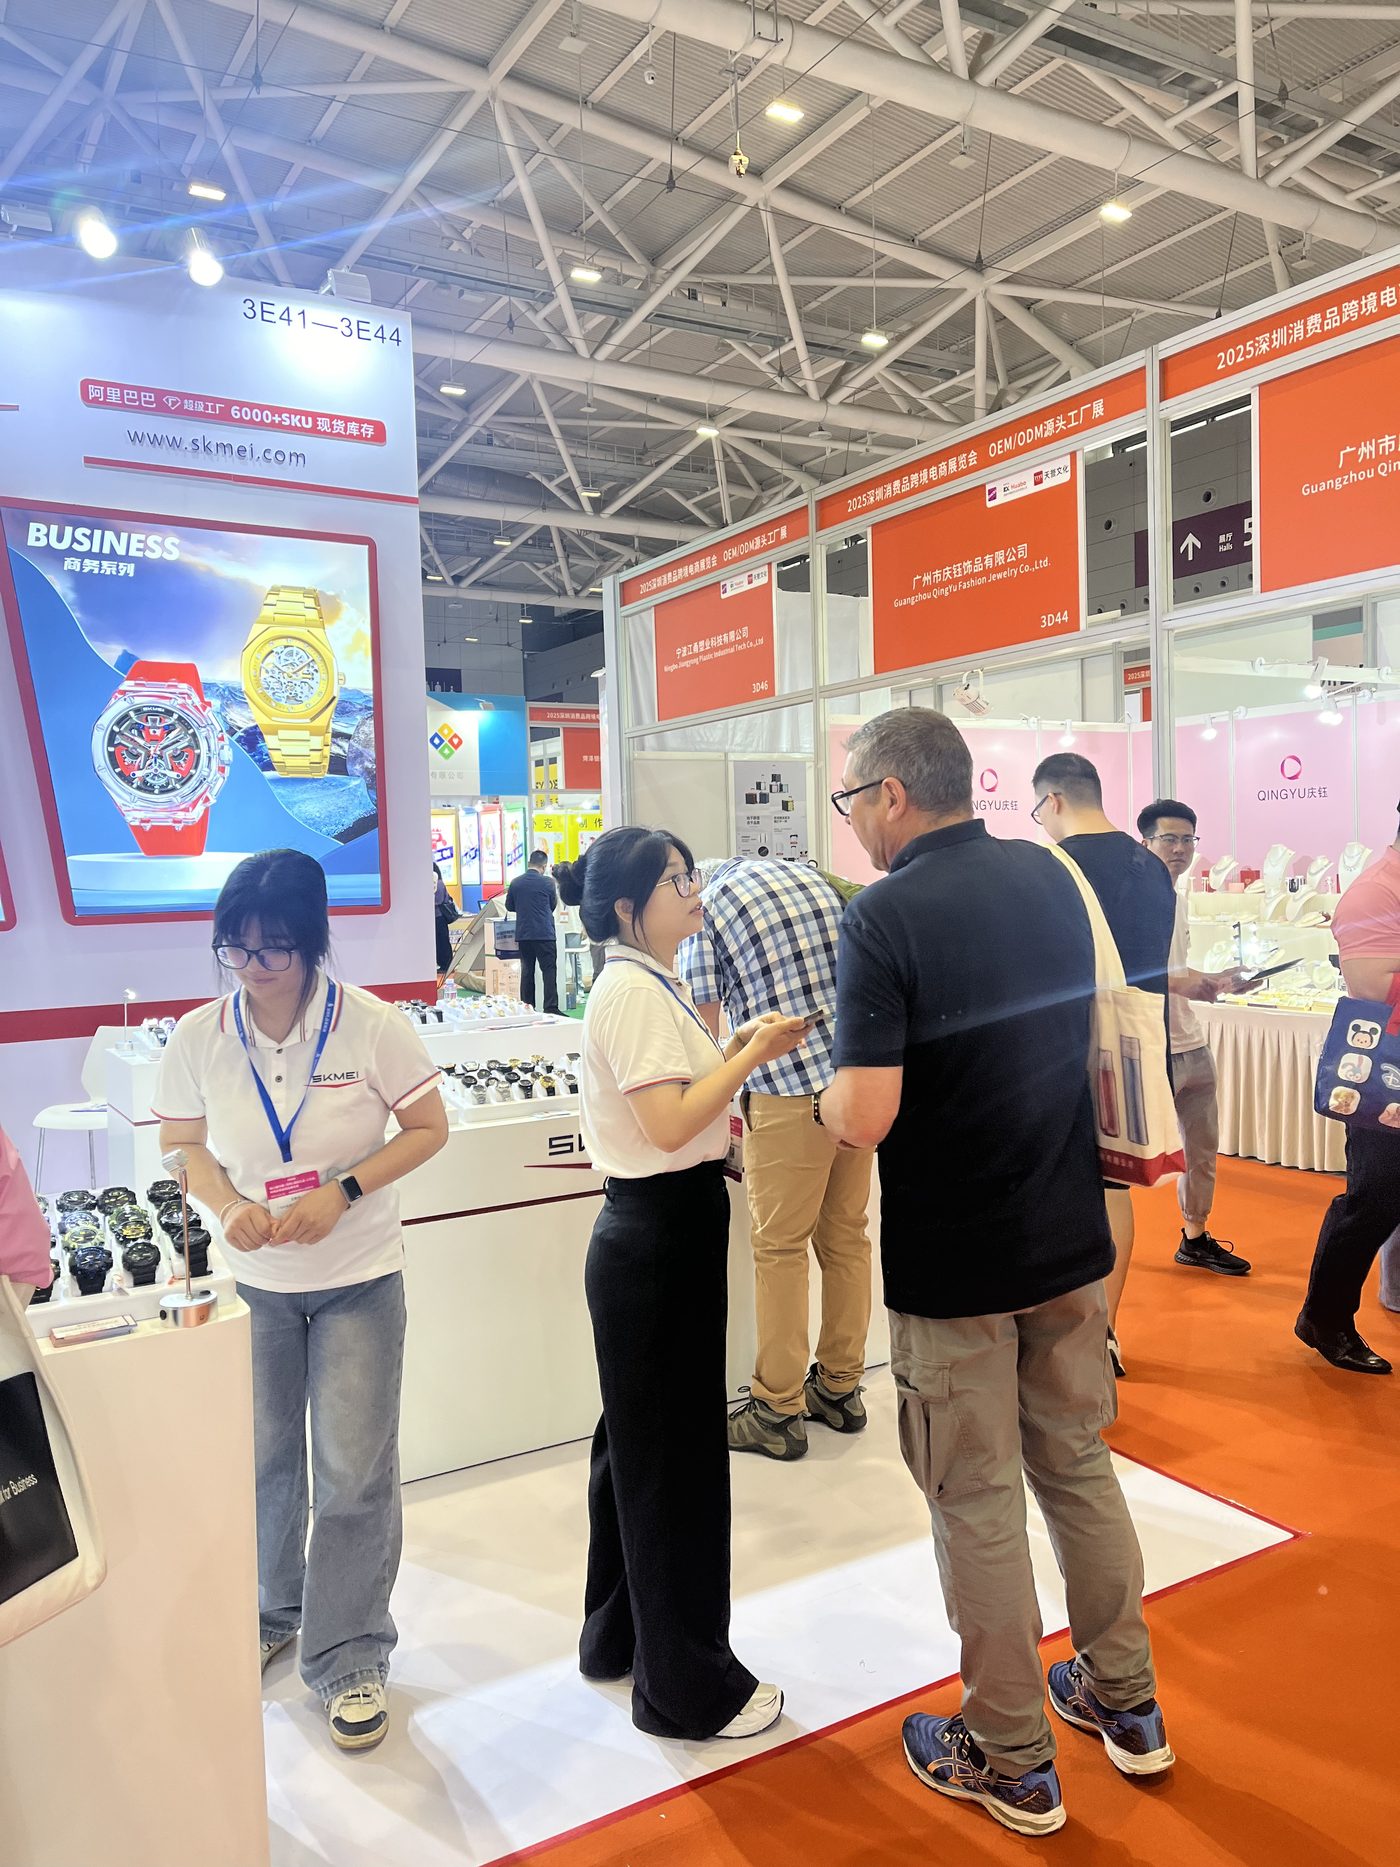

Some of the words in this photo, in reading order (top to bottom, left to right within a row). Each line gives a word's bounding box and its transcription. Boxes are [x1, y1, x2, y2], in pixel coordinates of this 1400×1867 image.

[1216, 282, 1400, 371] 2025深圳消费品跨境电
[88, 384, 156, 408] 阿里巴巴
[183, 398, 224, 415] 超级工厂
[230, 405, 313, 429] 6000+SKU
[316, 416, 375, 439] 现货库存
[126, 427, 307, 466] www.skmei.com
[847, 449, 978, 513] 2025深圳消费品跨境电商展览会
[988, 398, 1105, 458] OEM/ODM源头工厂展
[1338, 434, 1400, 469] 广州市
[1301, 464, 1375, 496] Guangzhou
[1377, 460, 1400, 477] Qin
[26, 521, 181, 562] BUSINESS
[1218, 542, 1233, 553] Halls
[63, 557, 136, 578] 商务系列
[639, 554, 718, 595] 2025深圳消费品跨境电商展览会
[723, 525, 788, 562] OEM/ODM源头工厂展
[912, 543, 1029, 590] 广州市庆钰饰品有限公司
[893, 591, 932, 608] Guangzhou
[932, 581, 958, 599] QingYu
[958, 574, 987, 592] Fashion
[987, 566, 1018, 585] Jewelry
[1018, 557, 1051, 576] Co.,Ltd.
[1040, 610, 1069, 629] 3D44
[735, 642, 746, 652] Tech
[752, 680, 769, 694] 3D46
[971, 799, 1018, 812] NGYU庆钰
[1257, 786, 1328, 802] QINGYU庆钰
[312, 1071, 359, 1084] SKMEI
[9, 1473, 38, 1496] Business
